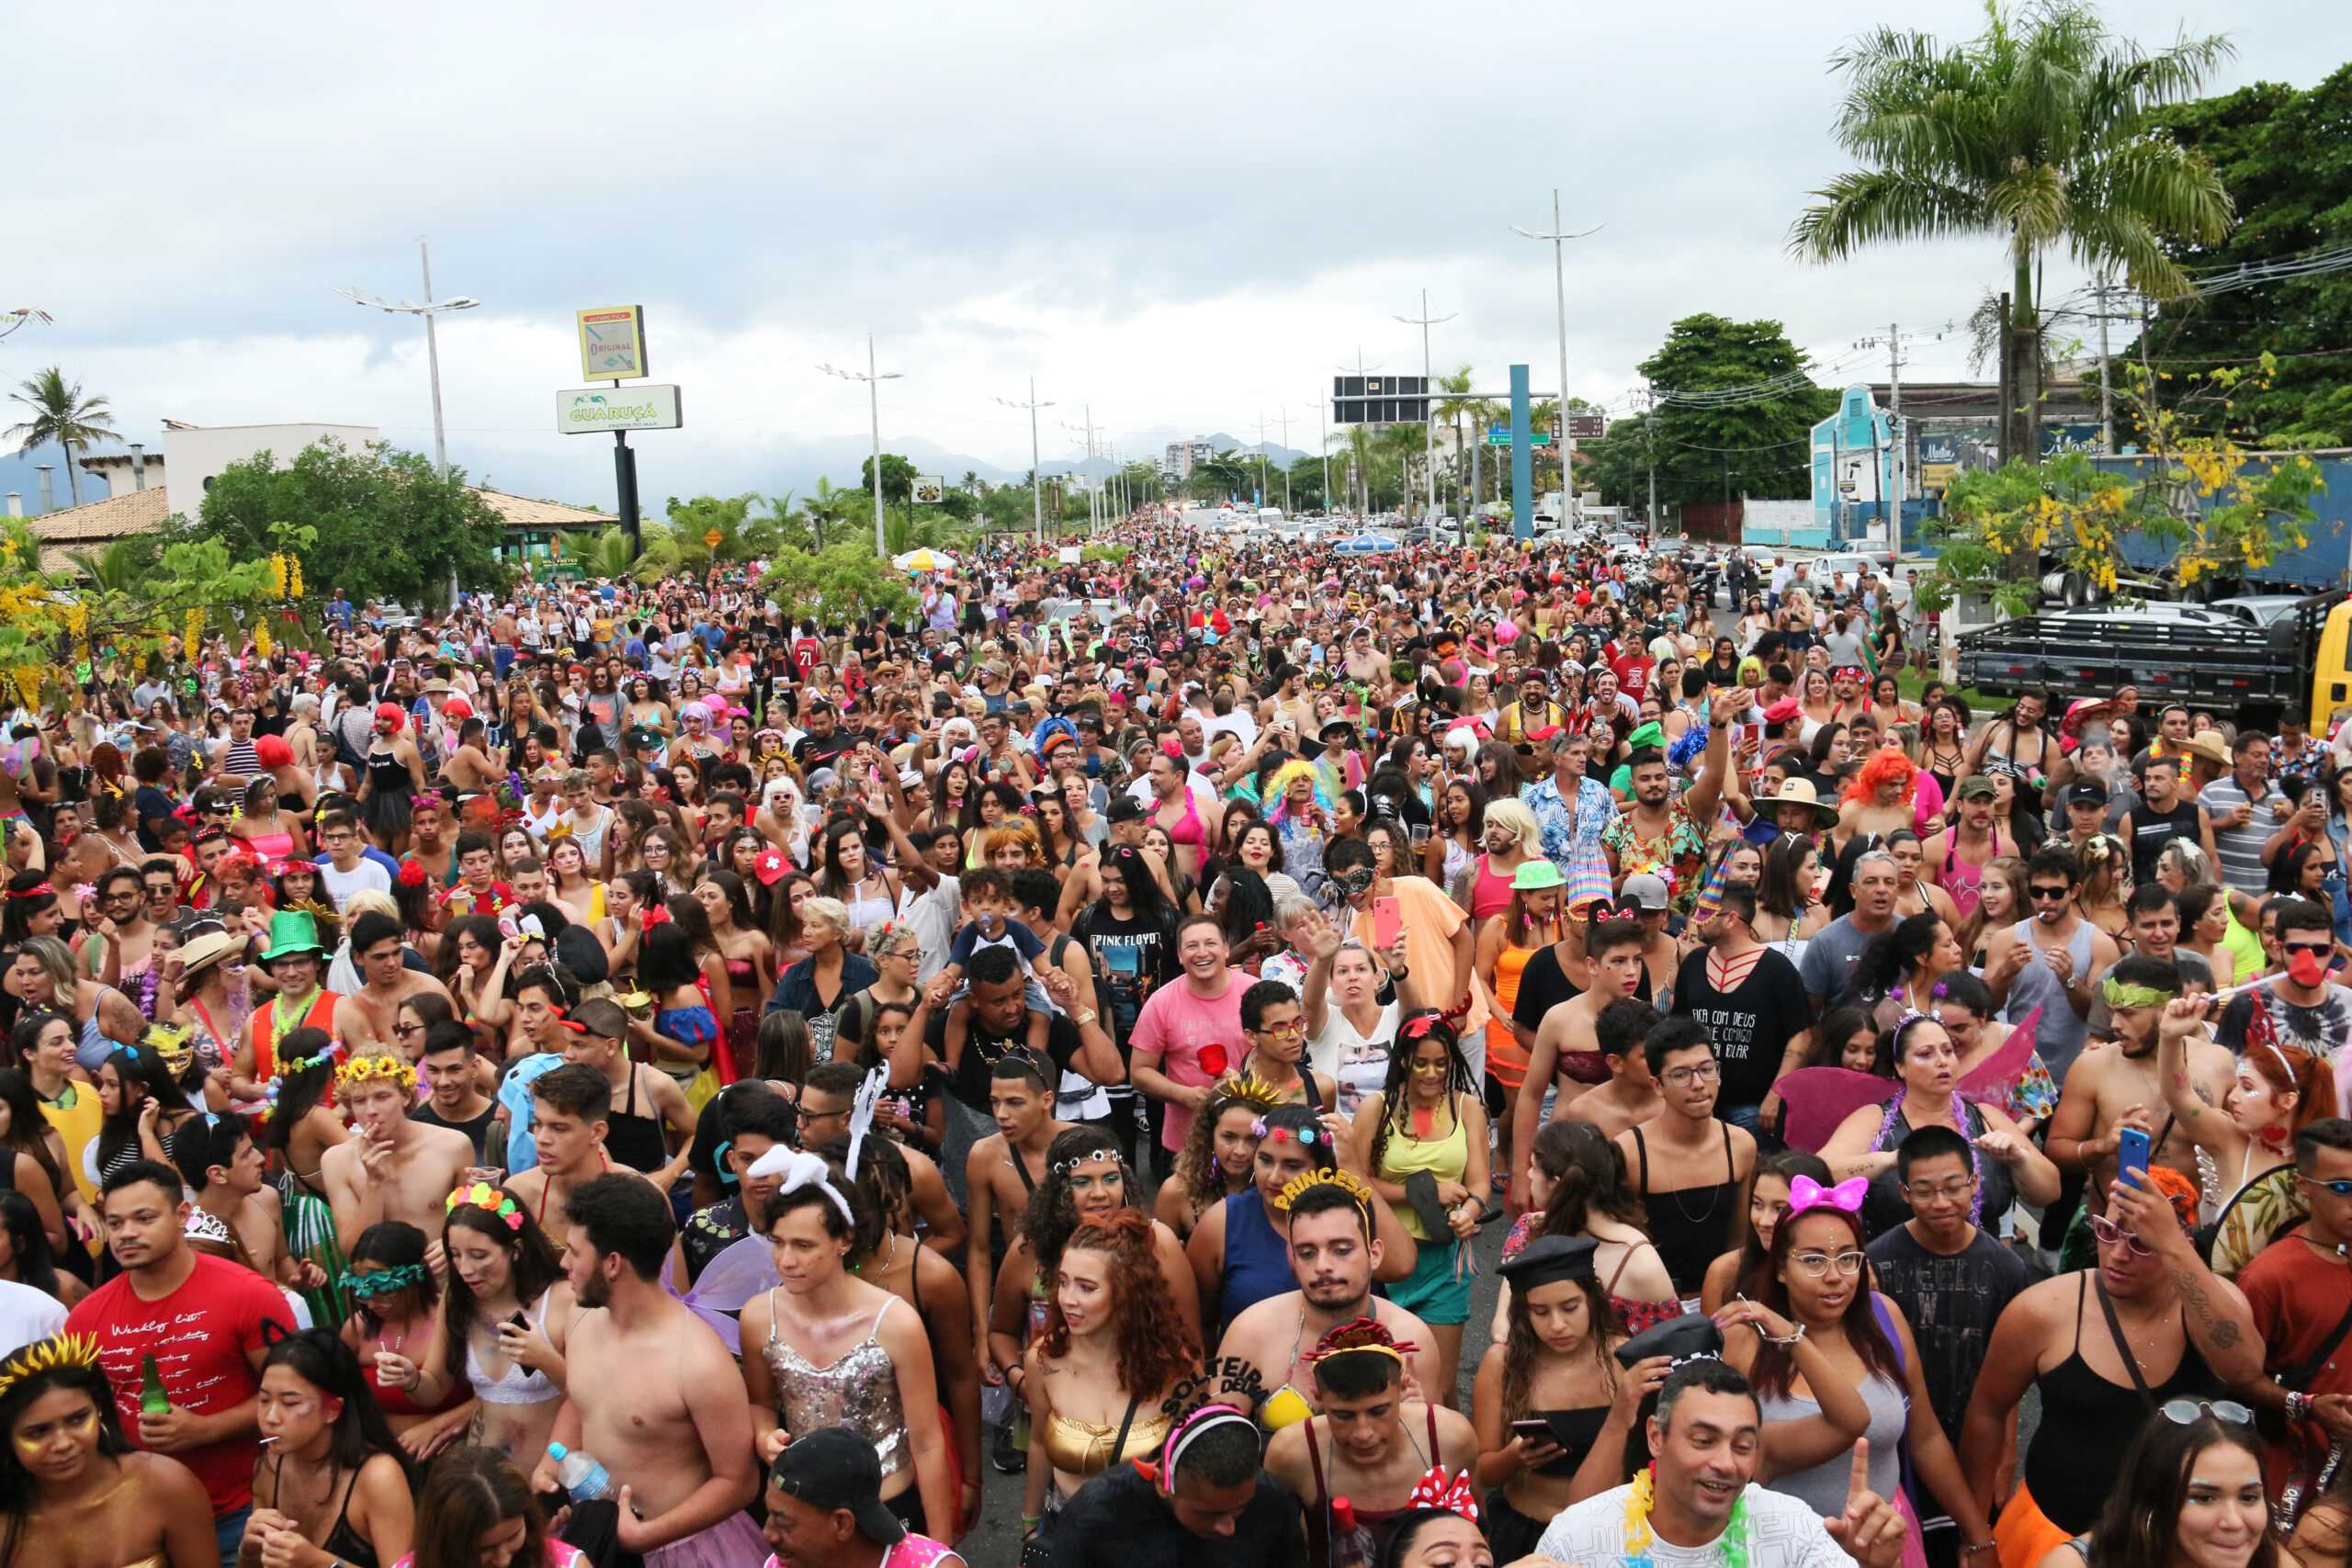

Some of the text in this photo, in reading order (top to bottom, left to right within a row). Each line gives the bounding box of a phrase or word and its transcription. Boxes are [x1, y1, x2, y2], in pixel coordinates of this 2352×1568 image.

[591, 342, 632, 356] ORIGINAL
[571, 401, 658, 422] GUARUÇÁ
[799, 651, 812, 666] 71
[1095, 932, 1156, 947] PINK FLOYD
[1712, 1010, 1729, 1025] COM
[1733, 1011, 1756, 1028] DEUS
[1274, 1167, 1372, 1210] PRINCESA
